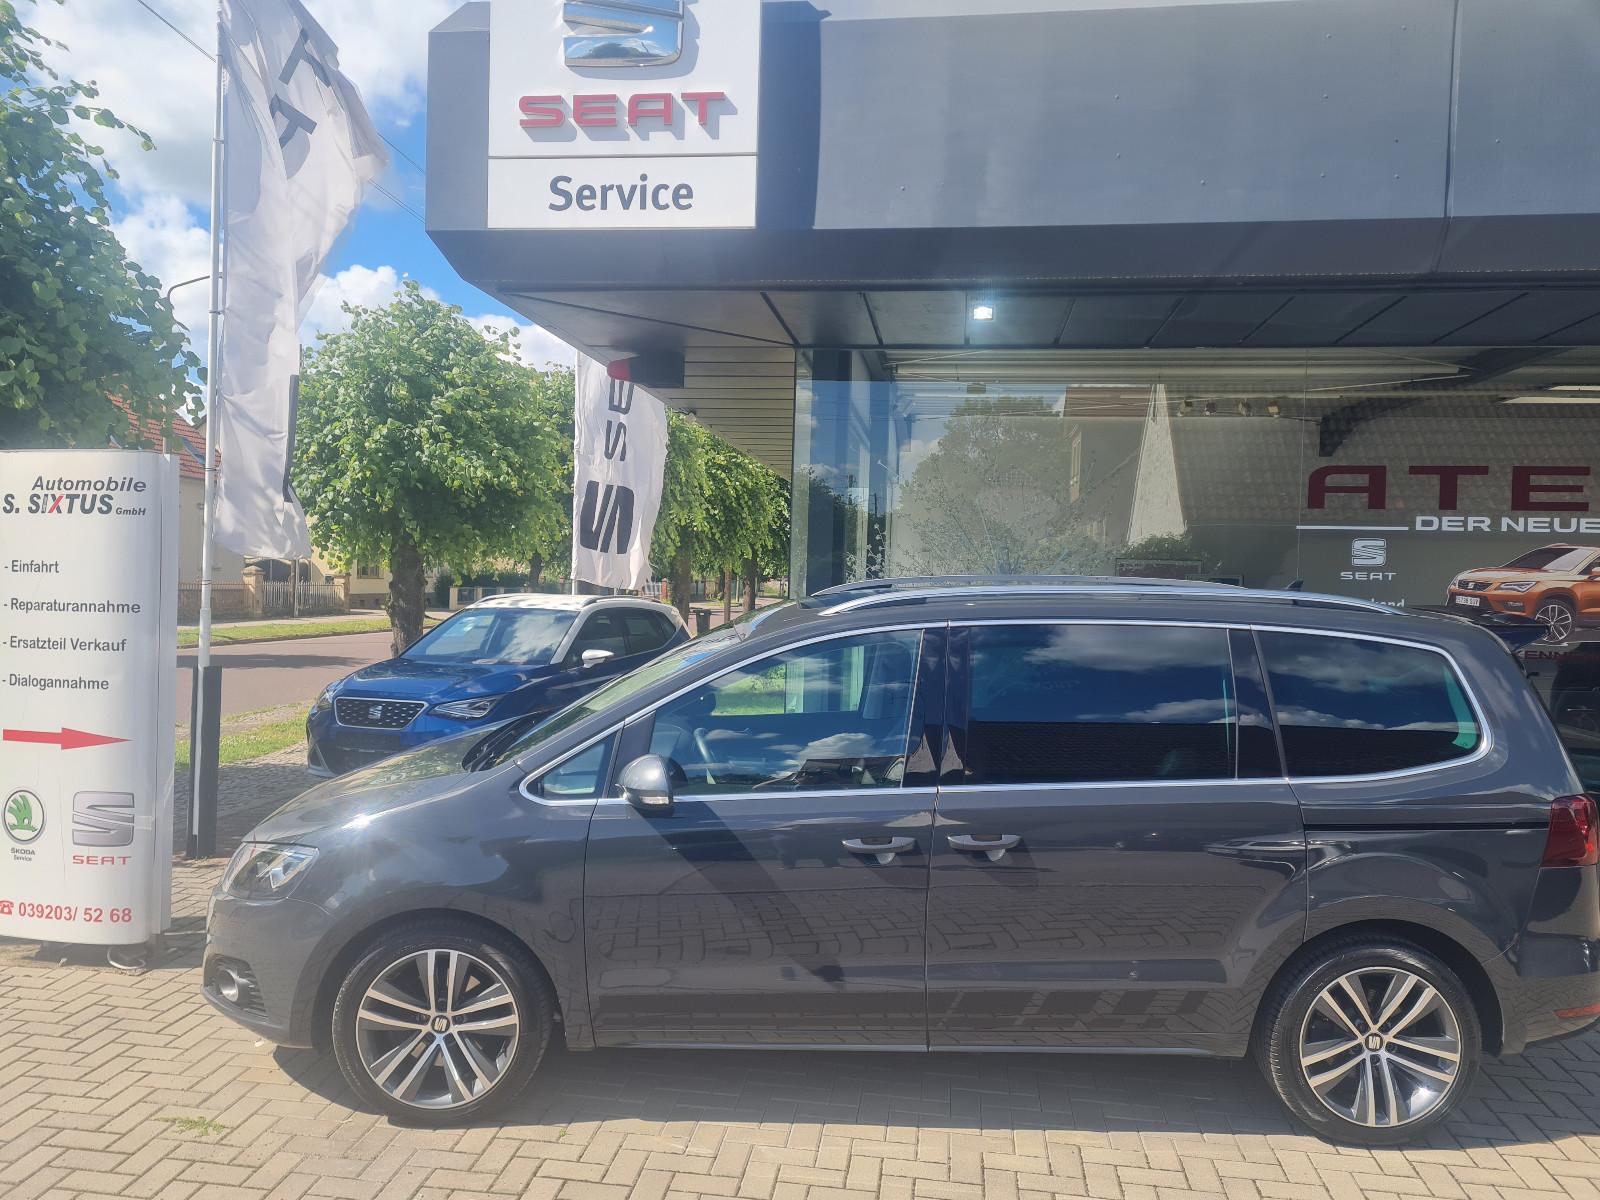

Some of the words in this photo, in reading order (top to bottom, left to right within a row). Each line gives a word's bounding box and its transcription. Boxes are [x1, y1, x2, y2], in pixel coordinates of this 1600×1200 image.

[519, 92, 726, 127] SEAT
[548, 173, 694, 211] Service
[32, 475, 147, 492] Automobile
[2, 493, 20, 514] S.
[115, 507, 146, 516] GmbH
[1415, 515, 1491, 532] DER
[1501, 517, 1600, 533] NEUE
[11, 560, 60, 574] Einfahrt
[1340, 572, 1397, 581] SEAT
[10, 598, 141, 614] Reparaturannahme
[9, 636, 67, 651] Ersatzteil
[70, 638, 127, 652] Verkauf
[9, 673, 109, 691] Dialogannahme
[73, 855, 131, 865] SEAT
[18, 902, 78, 921] 039203/
[83, 907, 103, 923] 52
[109, 908, 132, 923] 68
